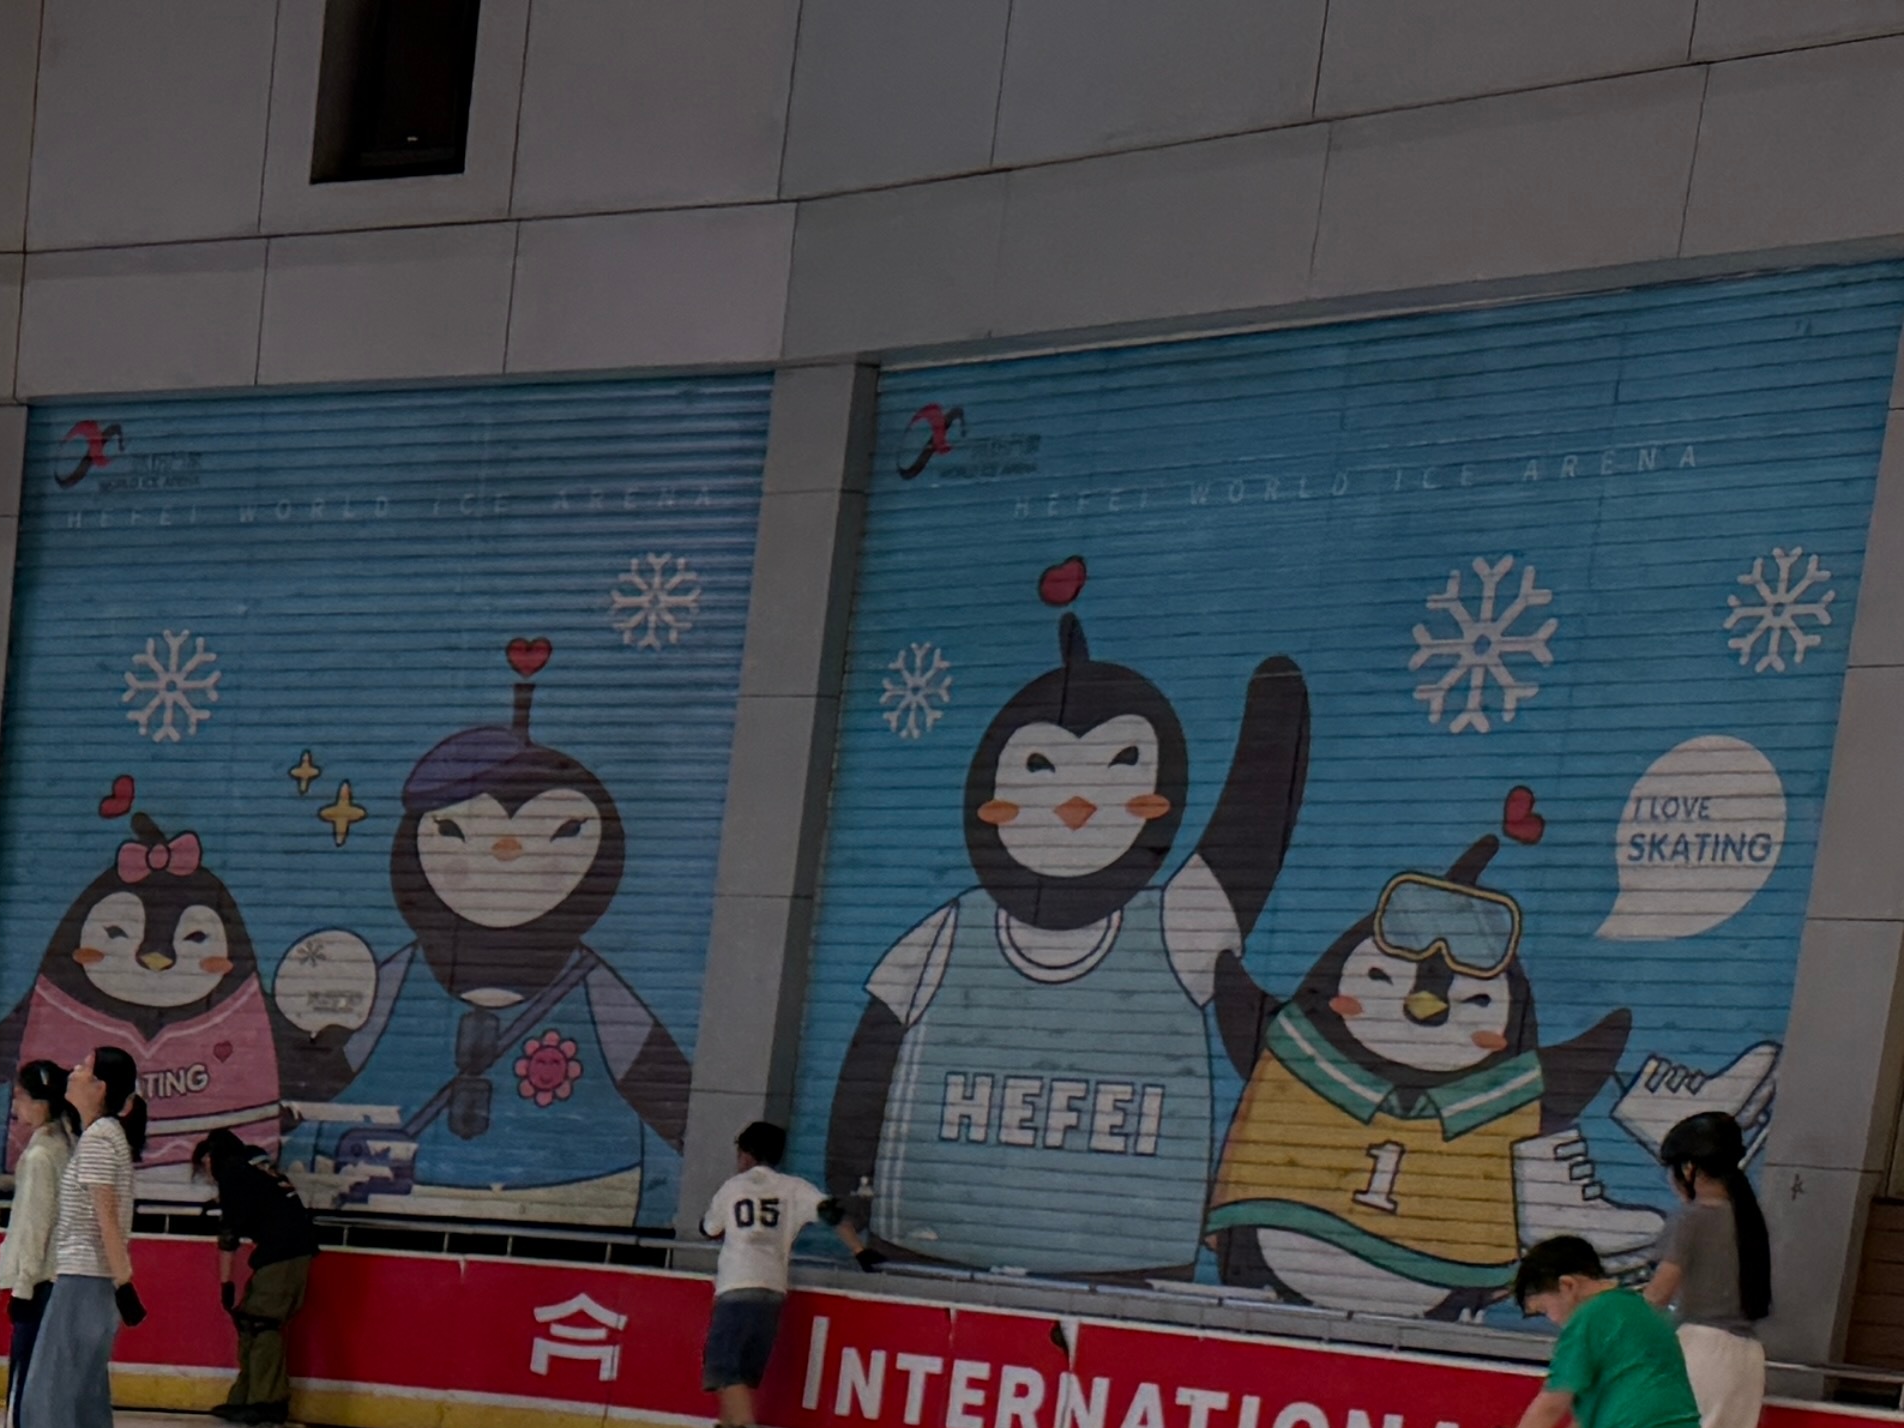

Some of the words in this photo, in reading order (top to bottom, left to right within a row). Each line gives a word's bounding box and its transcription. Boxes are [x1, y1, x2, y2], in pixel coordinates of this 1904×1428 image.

[1649, 796, 1712, 820] LOVE
[1627, 833, 1773, 863] SKATING
[137, 1062, 211, 1099] TING
[938, 1071, 1166, 1157] HEFEI
[1351, 1139, 1407, 1216] 1
[734, 1198, 781, 1229] 05
